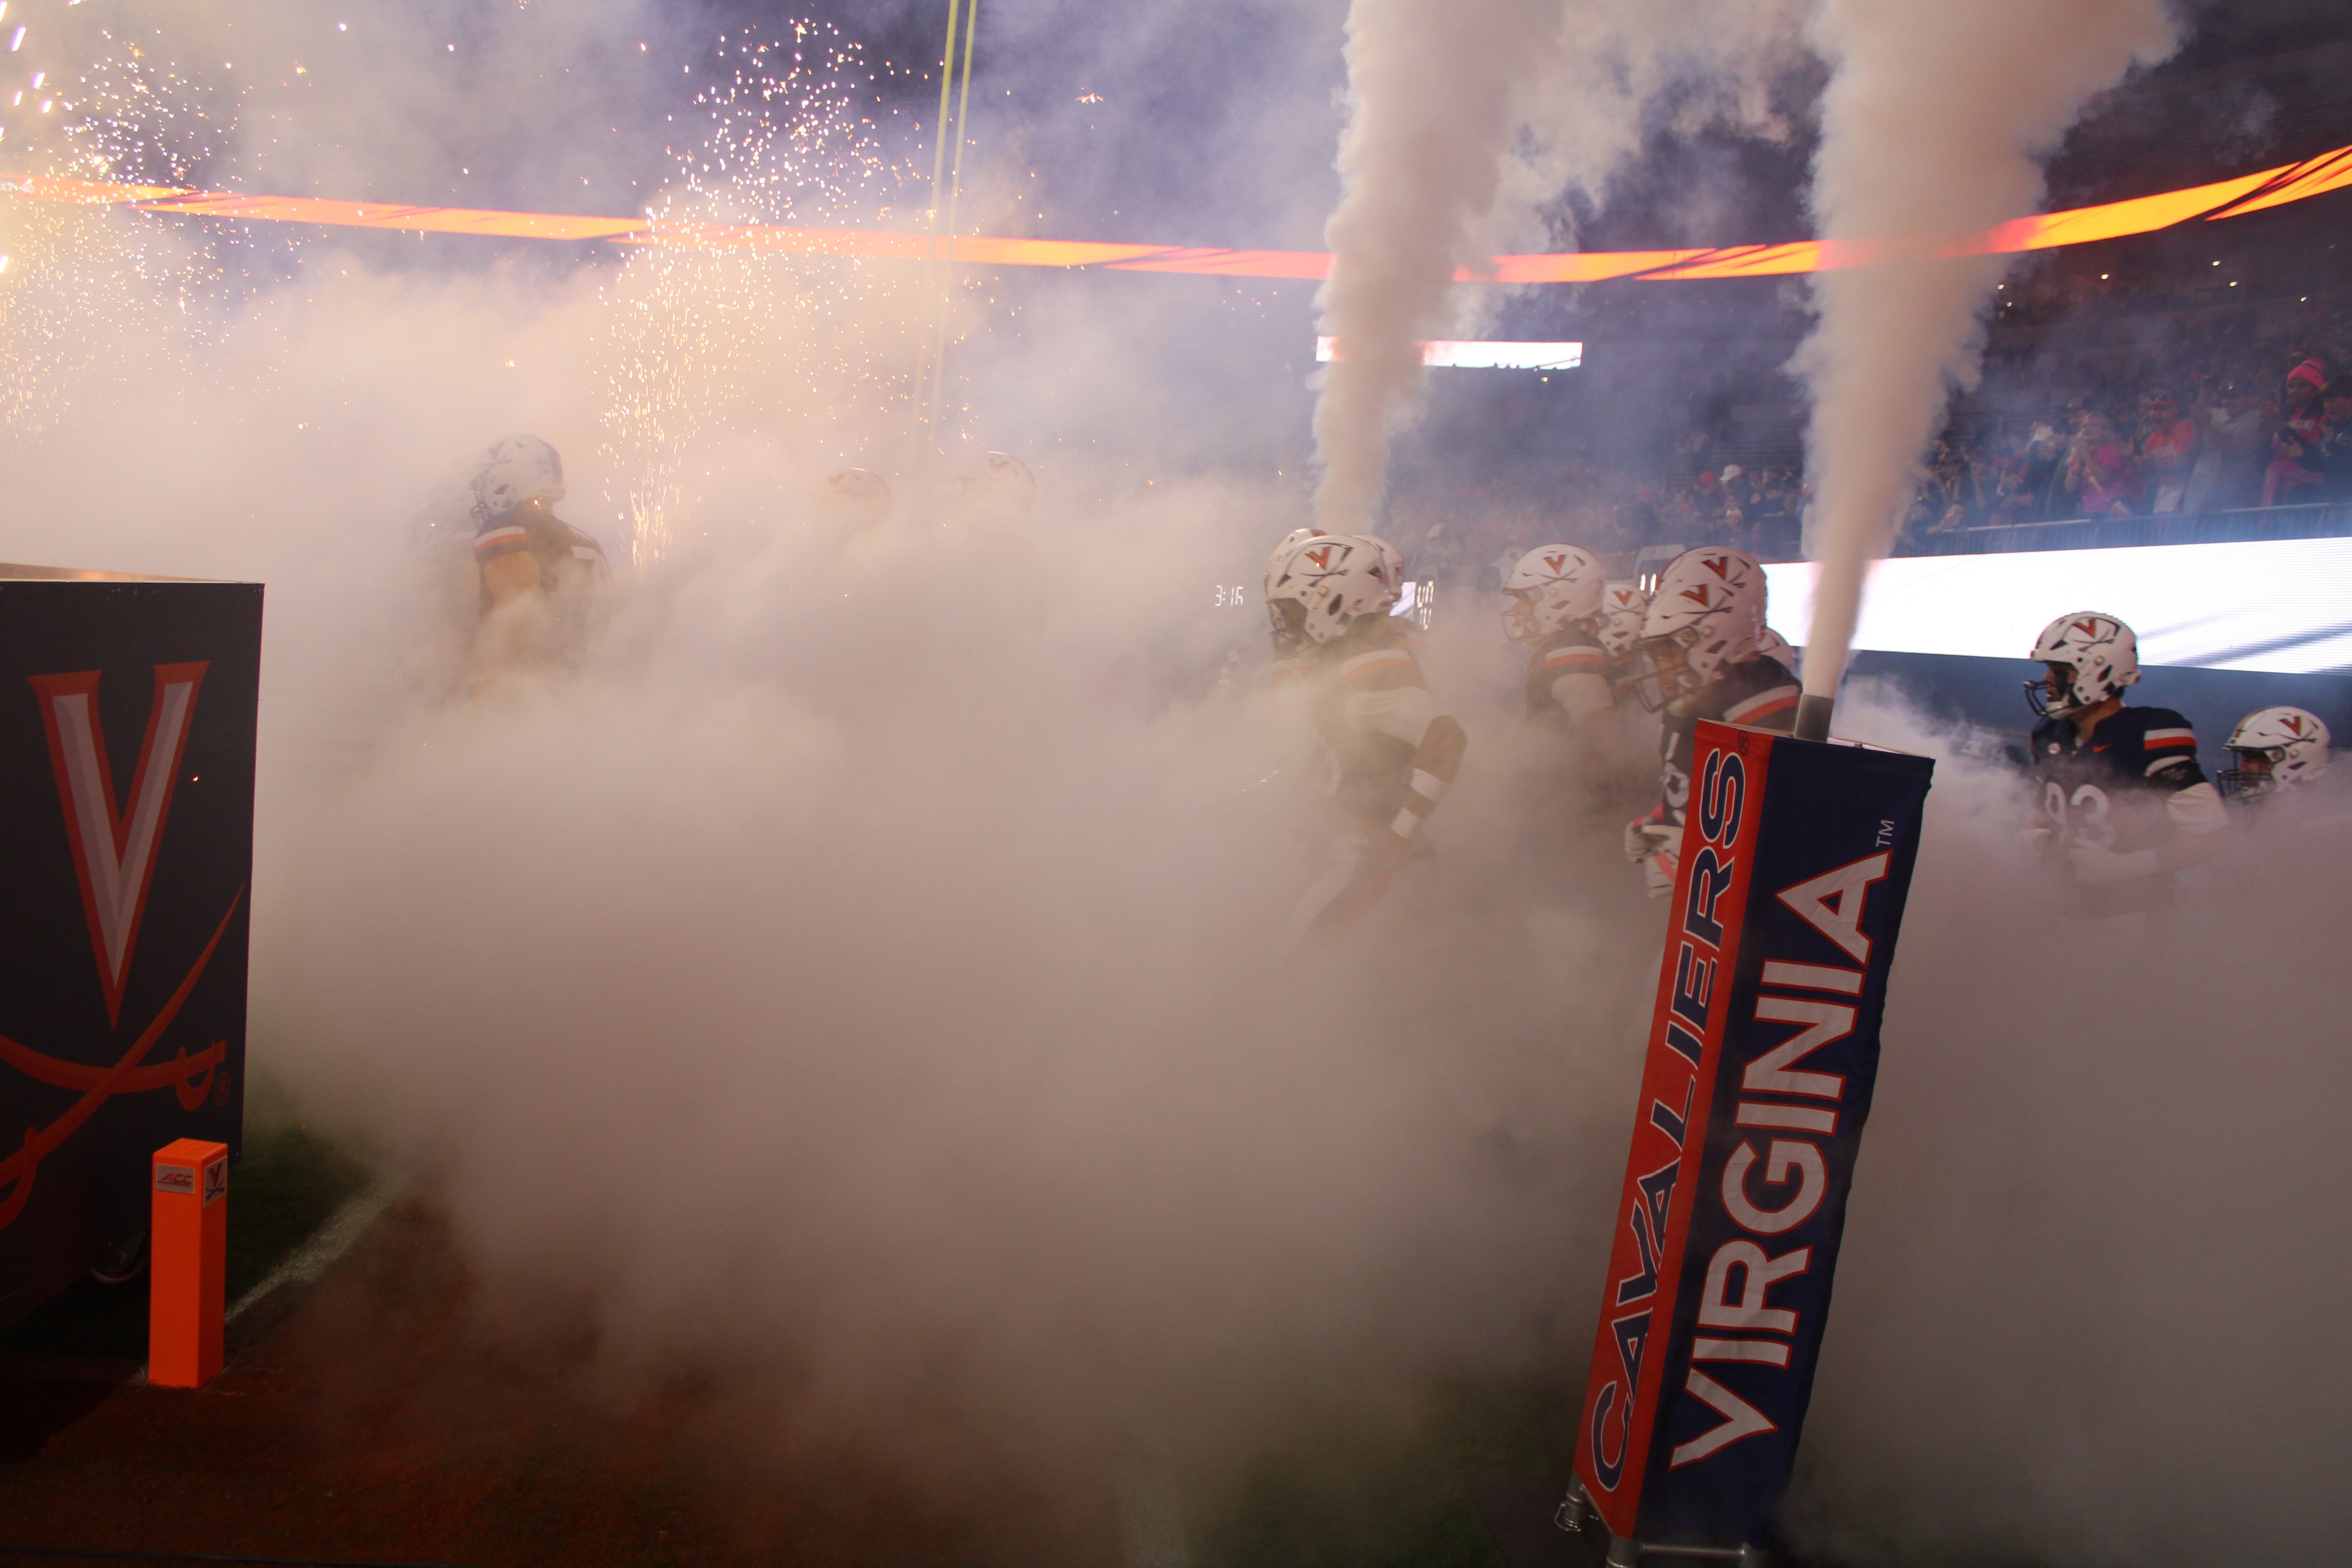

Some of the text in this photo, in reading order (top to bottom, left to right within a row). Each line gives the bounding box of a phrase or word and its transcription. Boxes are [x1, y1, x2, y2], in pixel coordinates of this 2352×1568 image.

[1215, 585, 1244, 606] 3:16
[26, 660, 211, 1033] V
[157, 1172, 194, 1187] ACC
[1591, 747, 1746, 1491] CAVALIERS
[1668, 849, 1893, 1471] VIRGINIA
